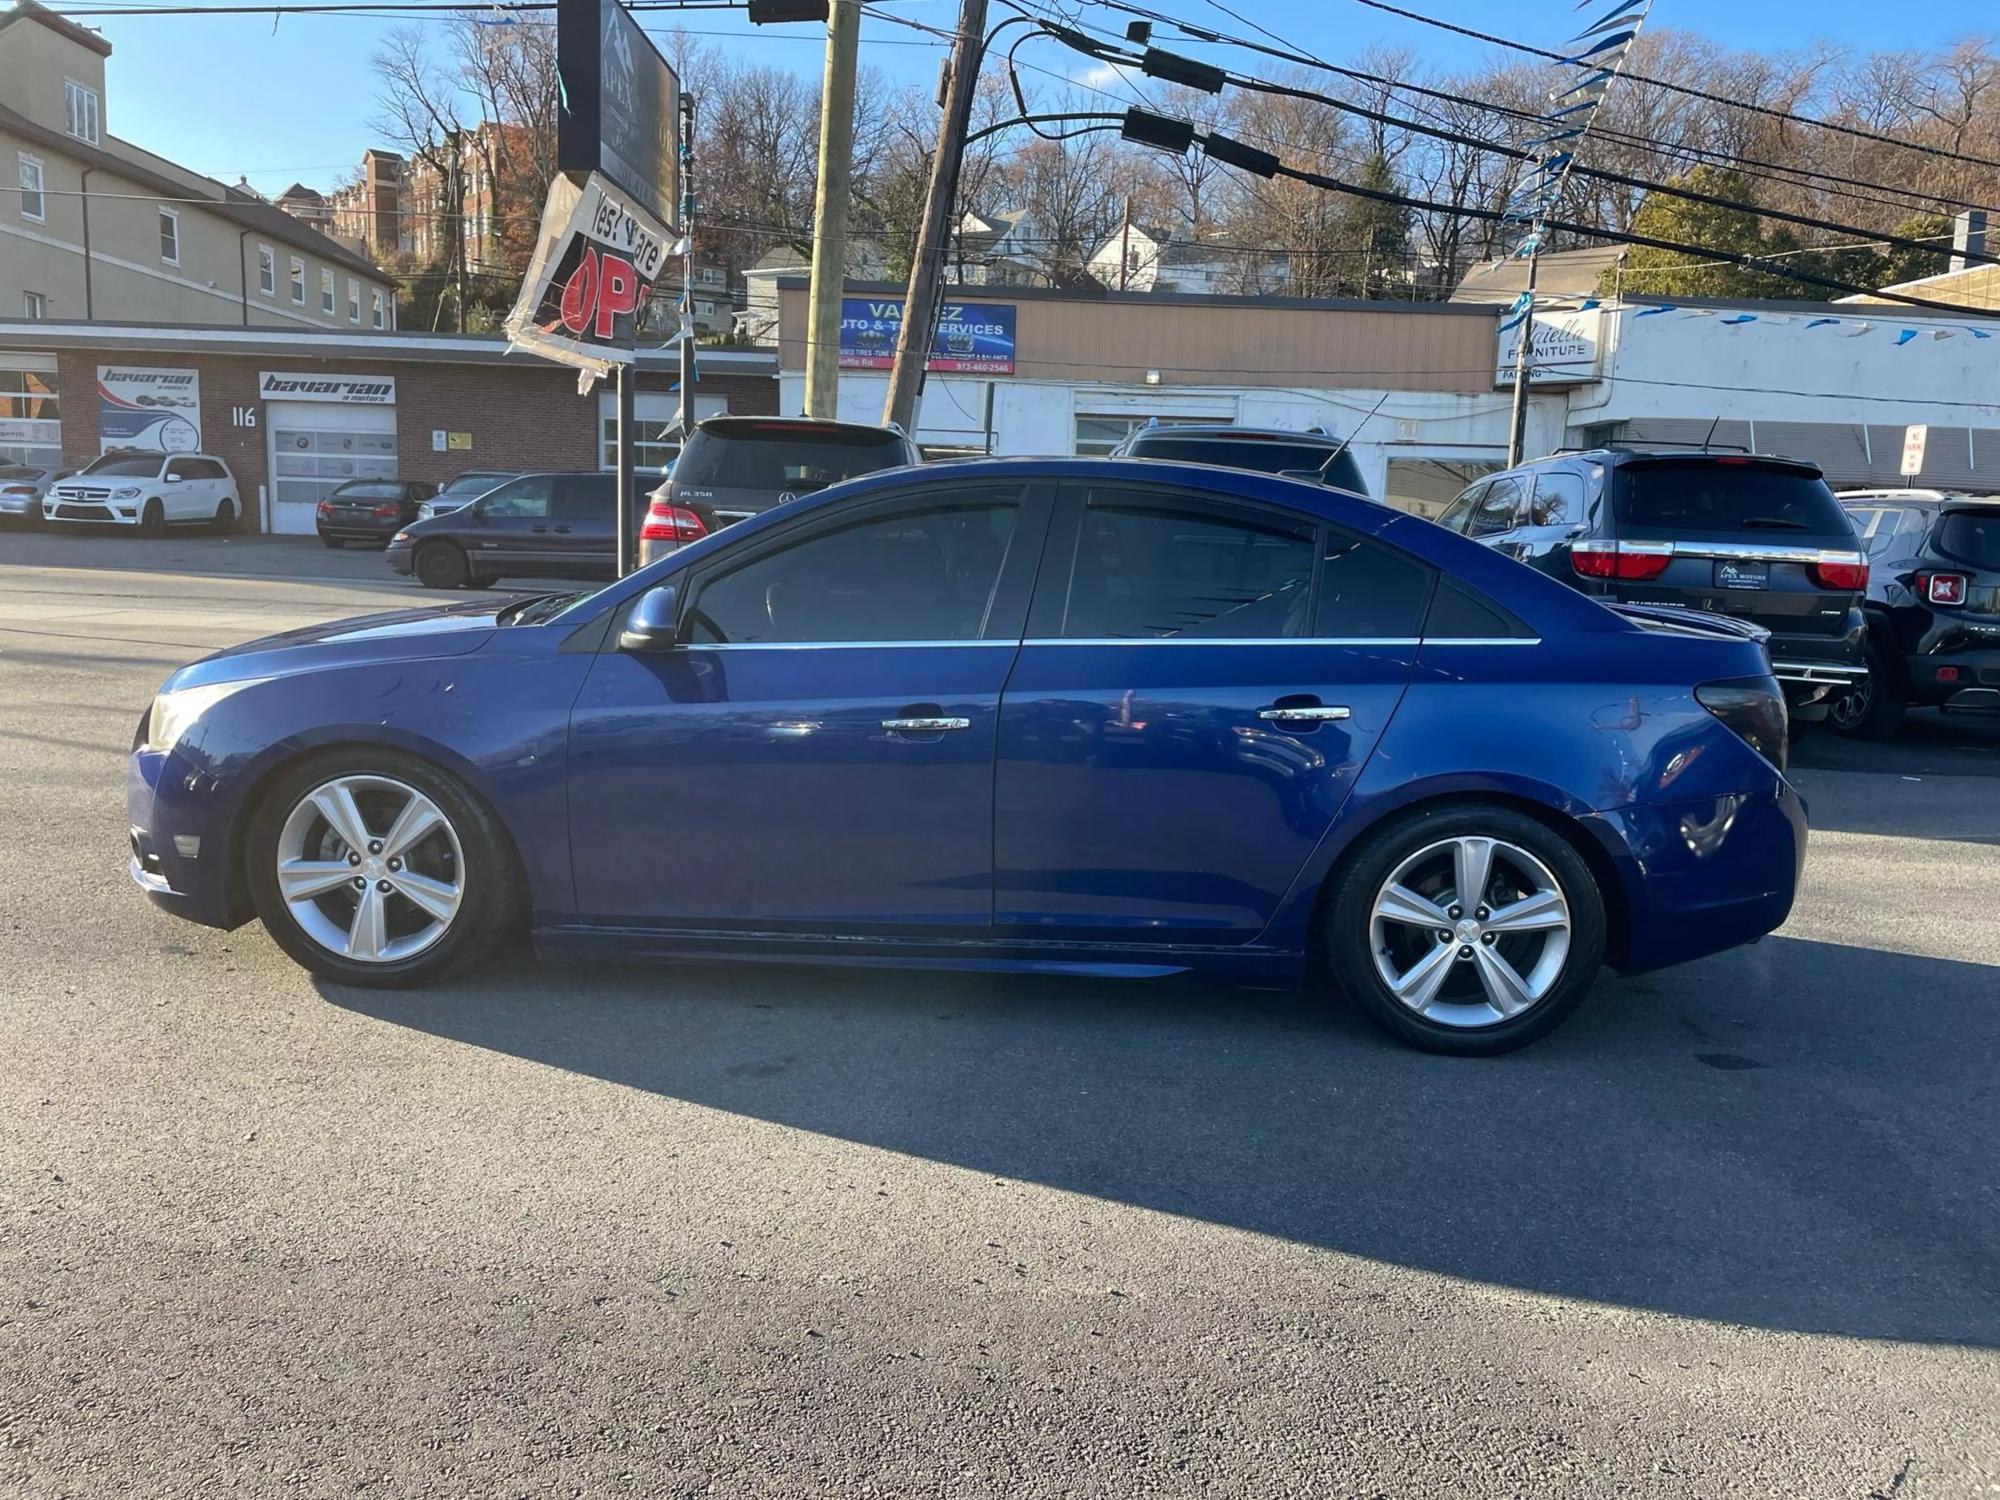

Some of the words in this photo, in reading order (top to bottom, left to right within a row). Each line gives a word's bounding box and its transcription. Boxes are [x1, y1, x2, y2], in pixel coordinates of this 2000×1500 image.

[591, 191, 624, 242] Yes!
[634, 233, 658, 271] are
[561, 247, 650, 339] OP
[873, 320, 884, 330] &
[938, 322, 1003, 335] ERVICES
[263, 374, 392, 395] bavarian
[233, 406, 255, 427] 116
